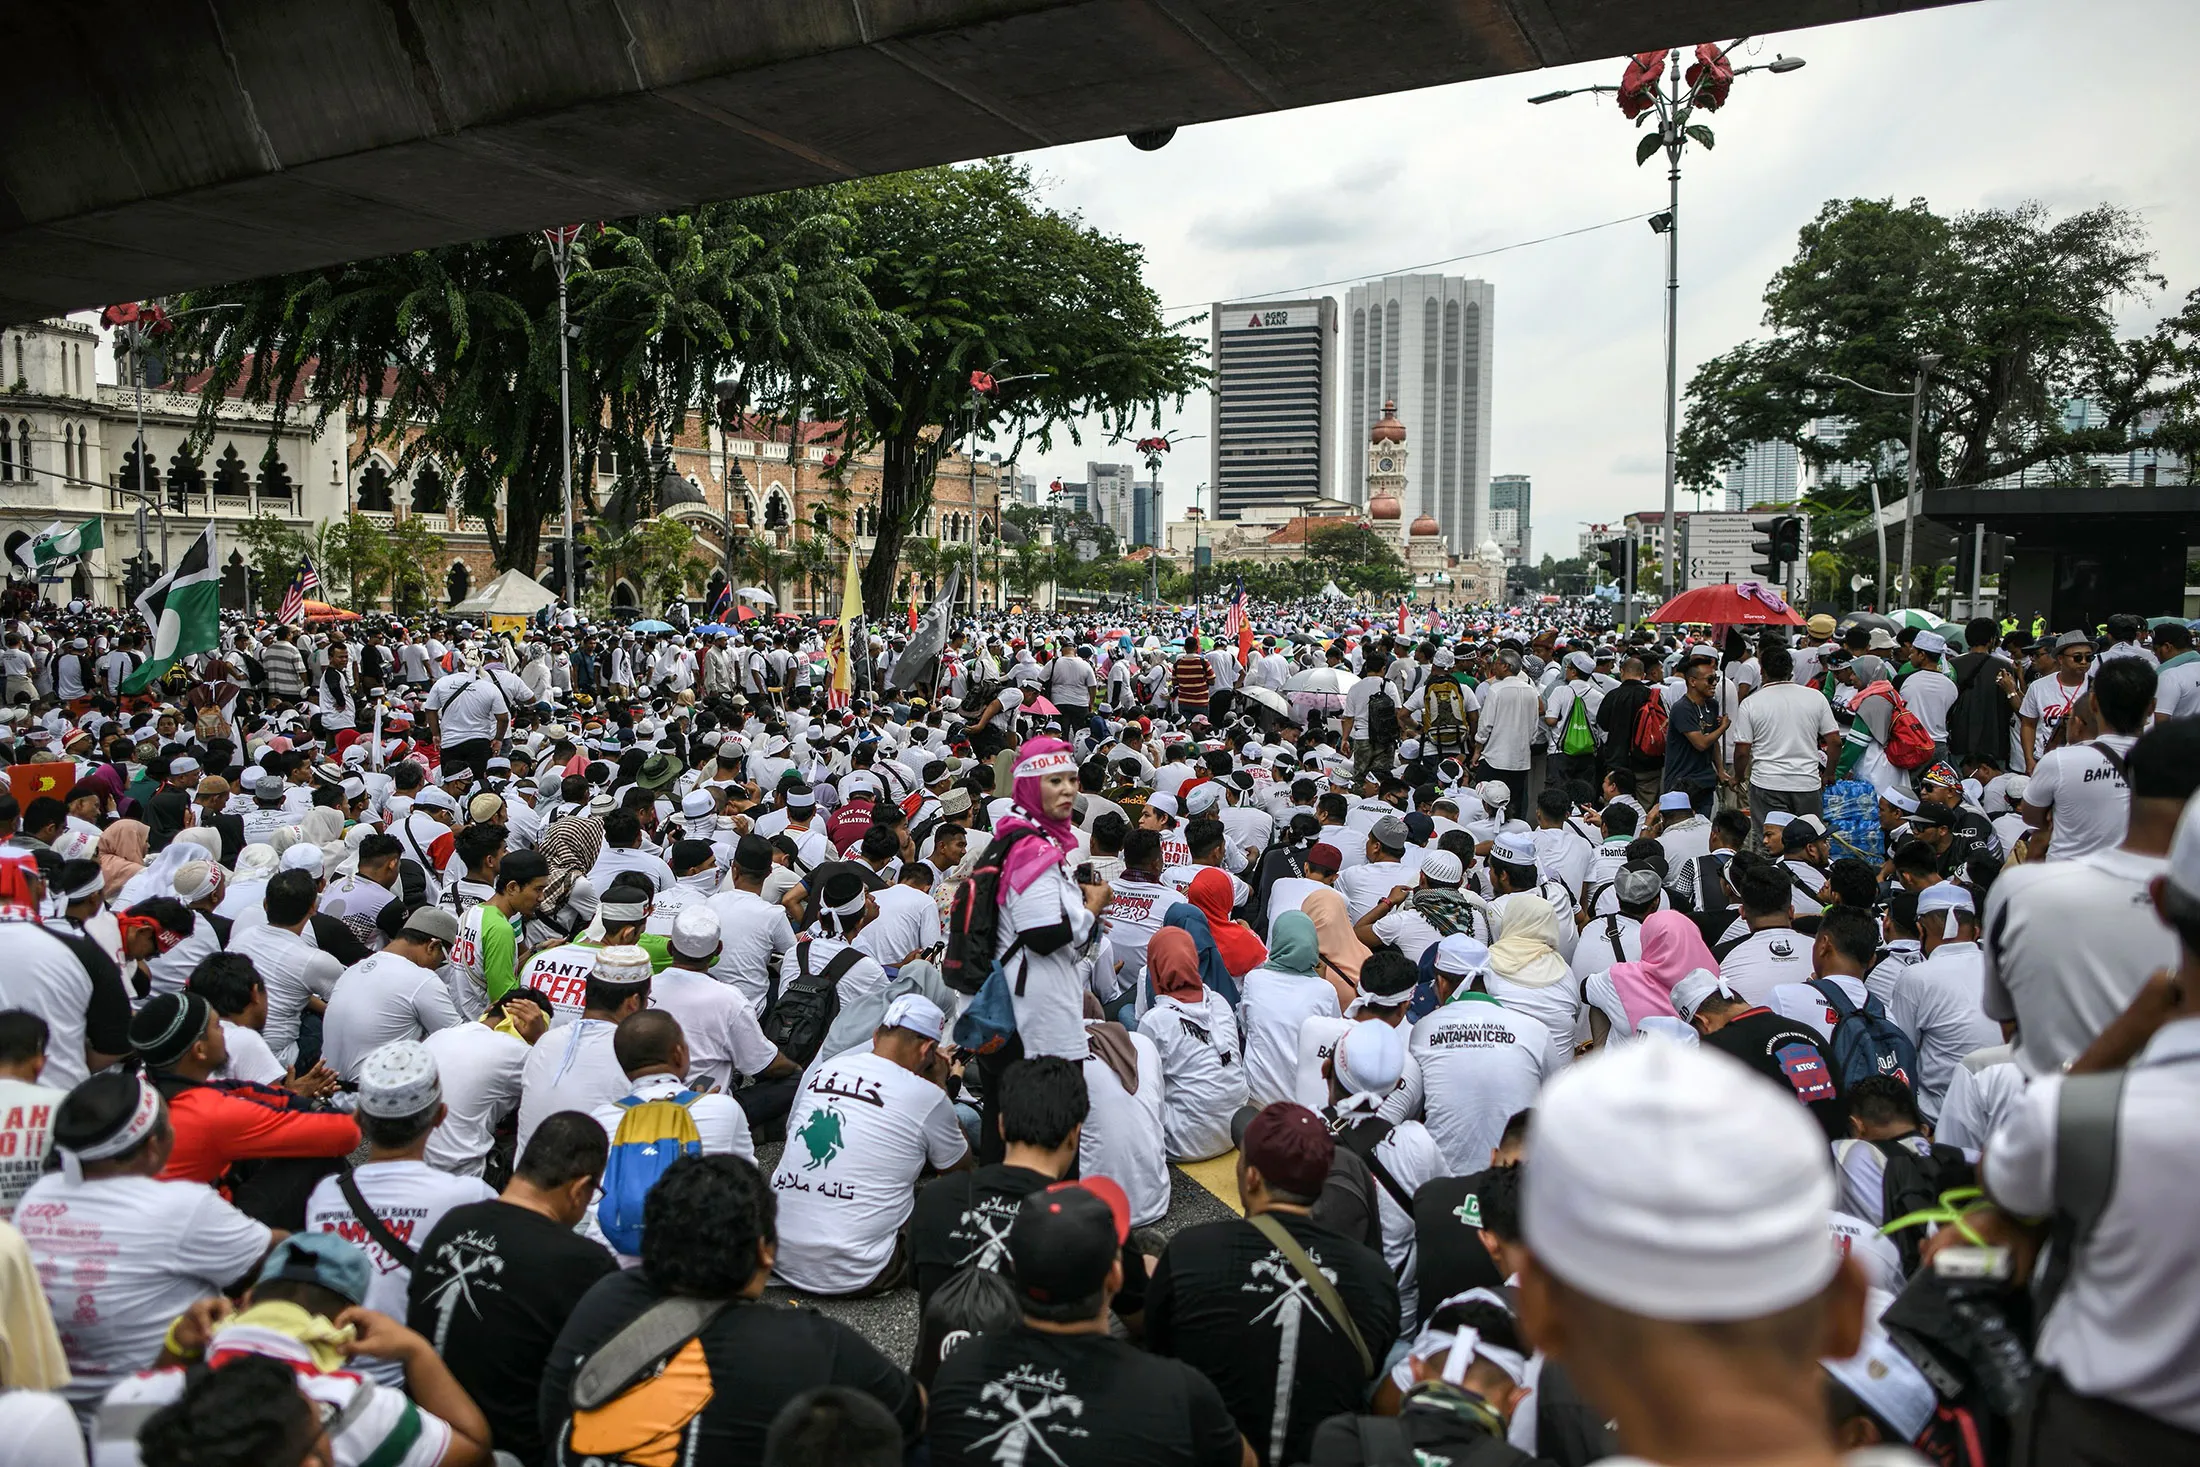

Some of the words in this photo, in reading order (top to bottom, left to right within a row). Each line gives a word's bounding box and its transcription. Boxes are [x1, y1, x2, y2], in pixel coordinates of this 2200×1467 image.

[1265, 311, 1288, 319] AGRO
[1031, 754, 1069, 769] TOLAK
[2083, 767, 2121, 783] BANT
[838, 809, 854, 820] UNIT
[839, 817, 870, 825] MALAYSIA
[1161, 842, 1189, 854] NTAH
[1601, 847, 1627, 857] #banta
[534, 959, 590, 979] BANT
[530, 972, 587, 1007] ICER
[1438, 1023, 1479, 1032] HIMPUNAN
[1480, 1023, 1505, 1032] AMAN
[1429, 1030, 1482, 1047] BANTAHAN
[1483, 1030, 1516, 1045] ICERD
[1795, 1061, 1818, 1073] KTOC
[0, 1104, 52, 1130] AH
[817, 1182, 856, 1201] تانه
[391, 1207, 429, 1219] RAKYAT
[322, 1218, 416, 1246] BANAH
